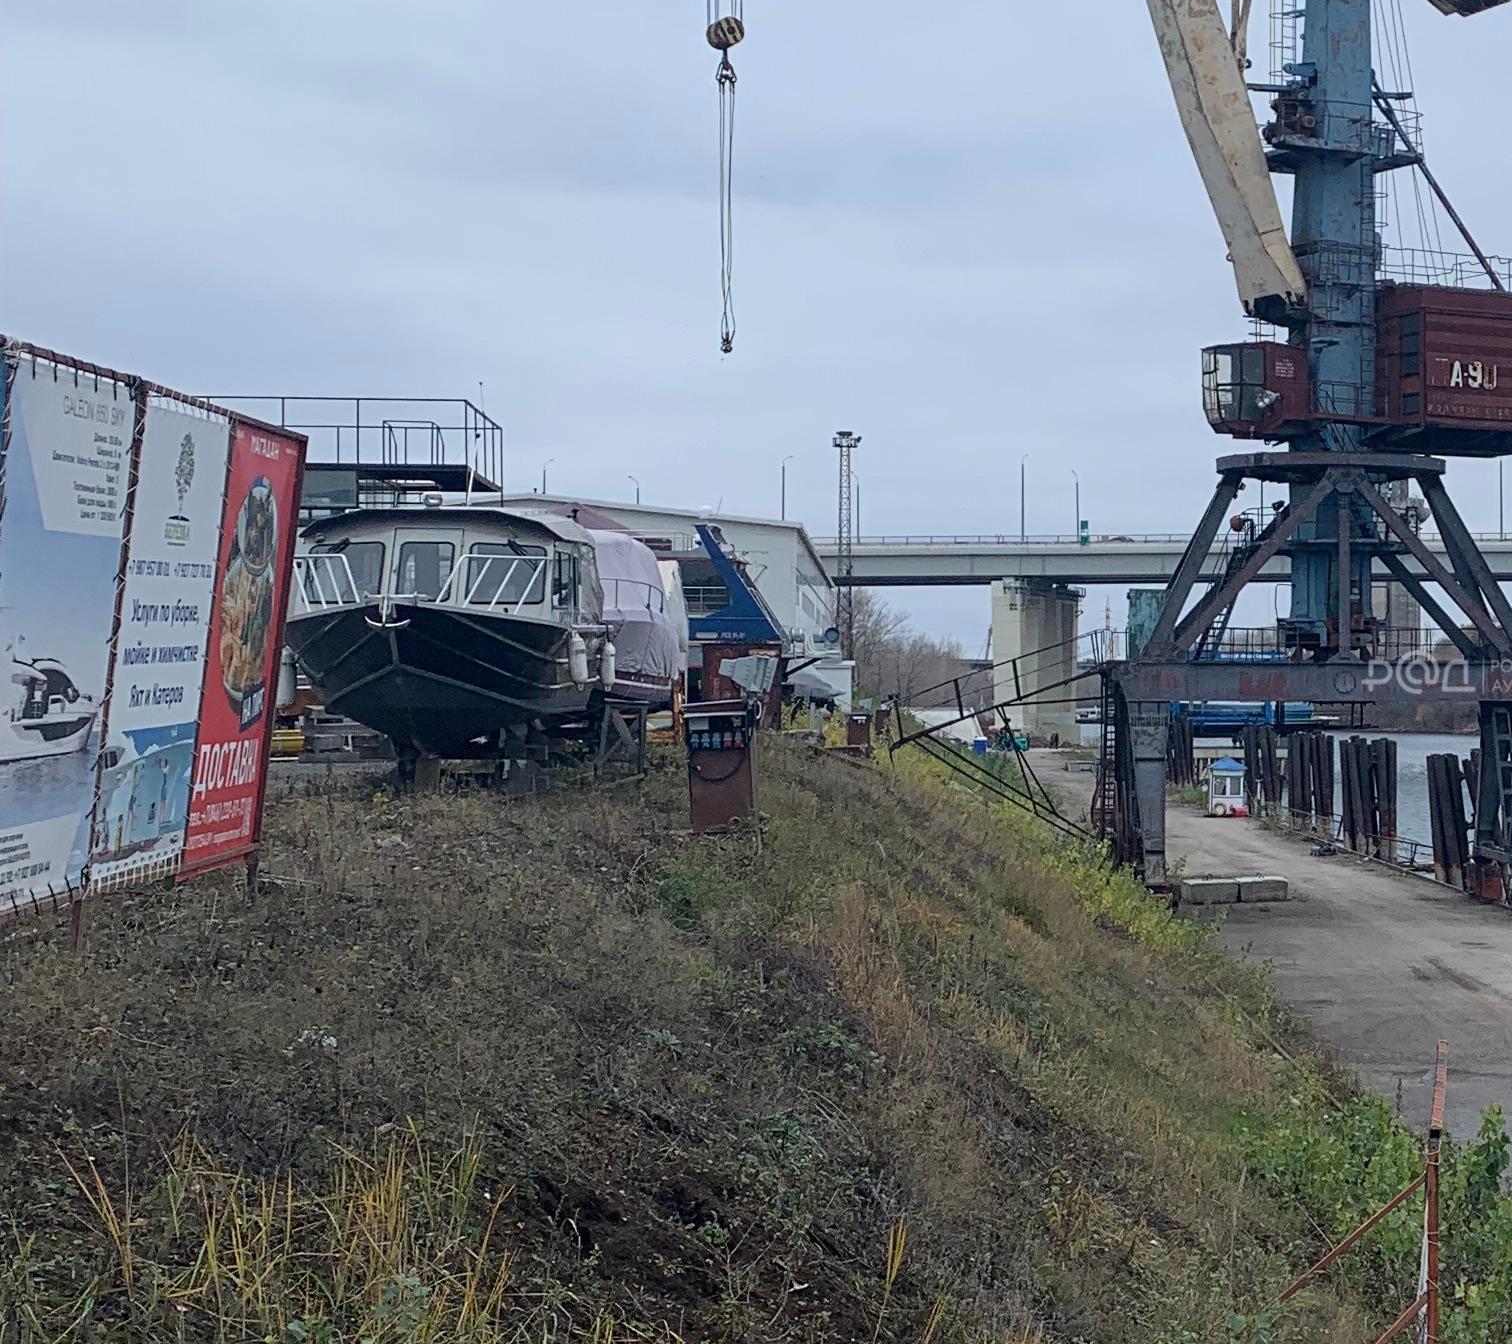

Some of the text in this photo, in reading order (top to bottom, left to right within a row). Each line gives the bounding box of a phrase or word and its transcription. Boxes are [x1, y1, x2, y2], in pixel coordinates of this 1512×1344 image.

[131, 598, 159, 628] Услуги
[159, 604, 170, 622] по
[122, 640, 150, 666] мойке
[150, 646, 158, 664] и
[129, 683, 184, 709] Яхт и Катеров
